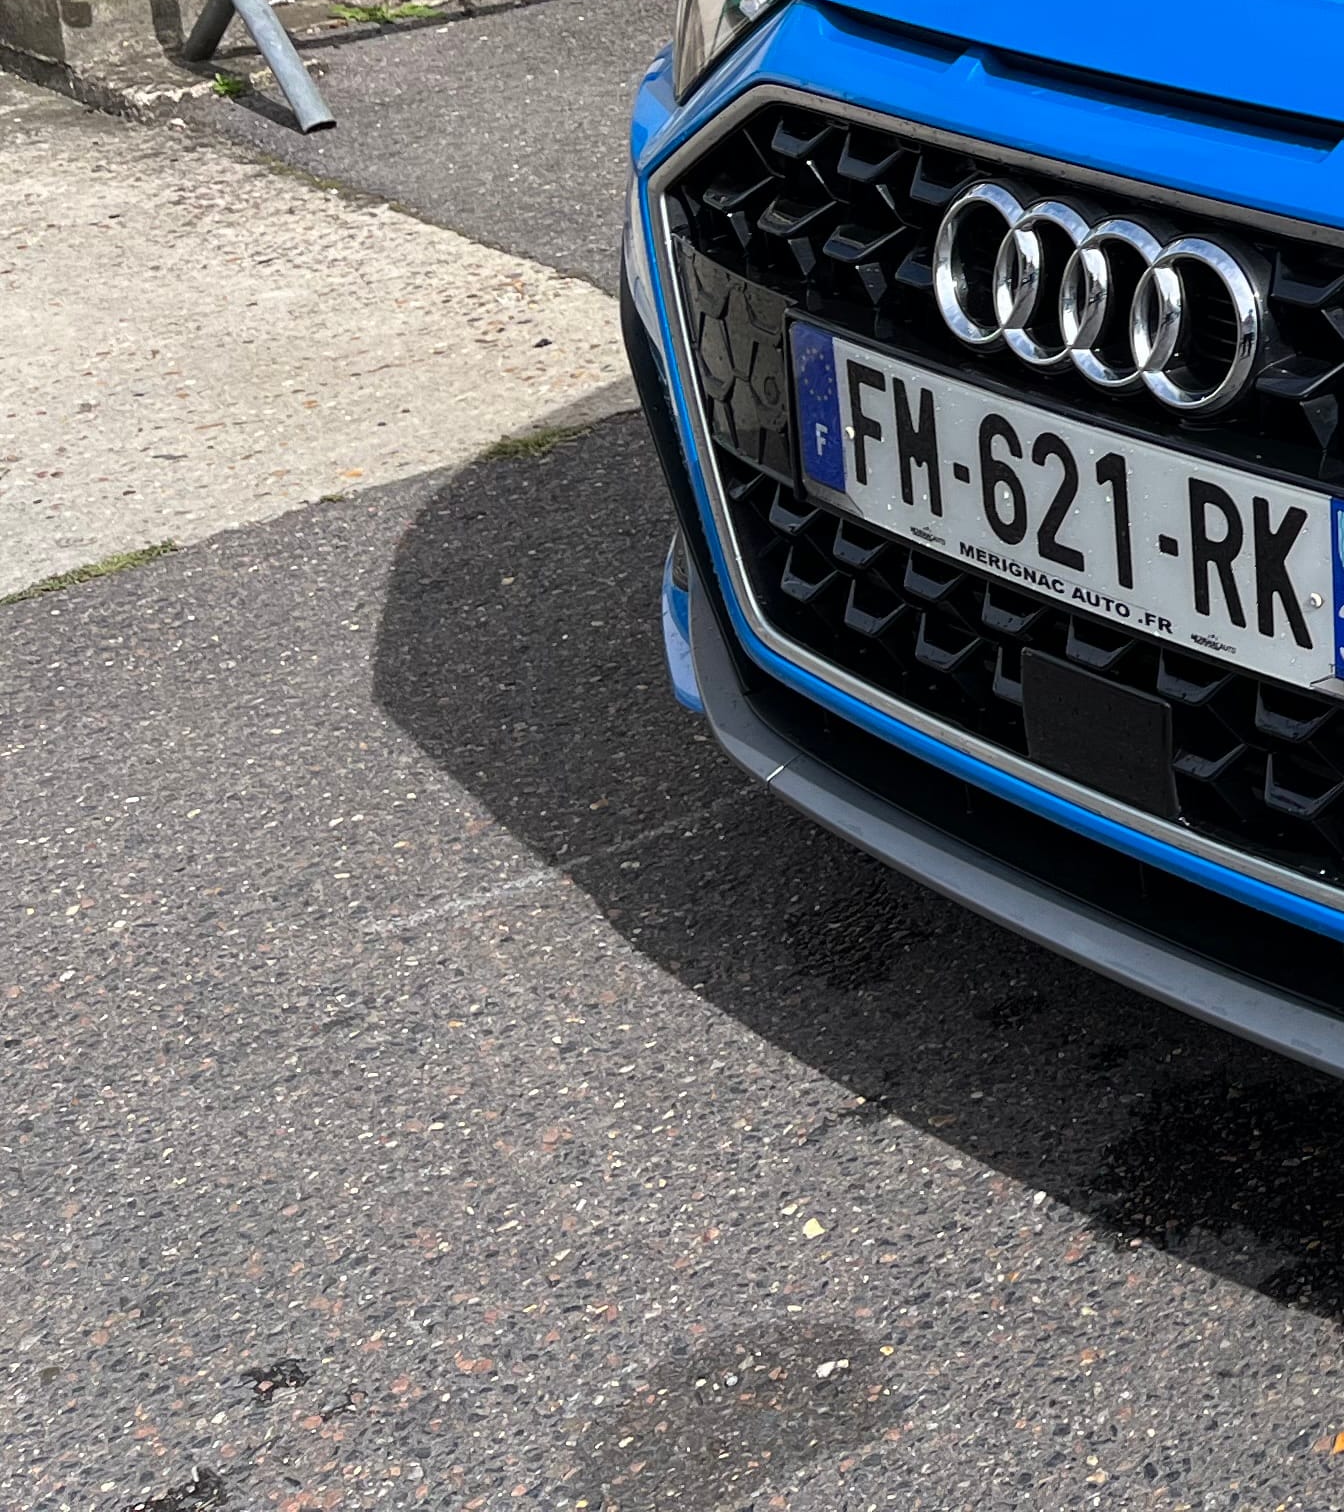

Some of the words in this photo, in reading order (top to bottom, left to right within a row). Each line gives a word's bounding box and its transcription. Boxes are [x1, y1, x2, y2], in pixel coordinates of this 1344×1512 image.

[815, 422, 829, 456] F
[846, 358, 1313, 650] FM-621-RK
[958, 541, 1065, 595] MERIGNAC
[1071, 587, 1131, 618] AUTO
[1137, 611, 1174, 634] .FR
